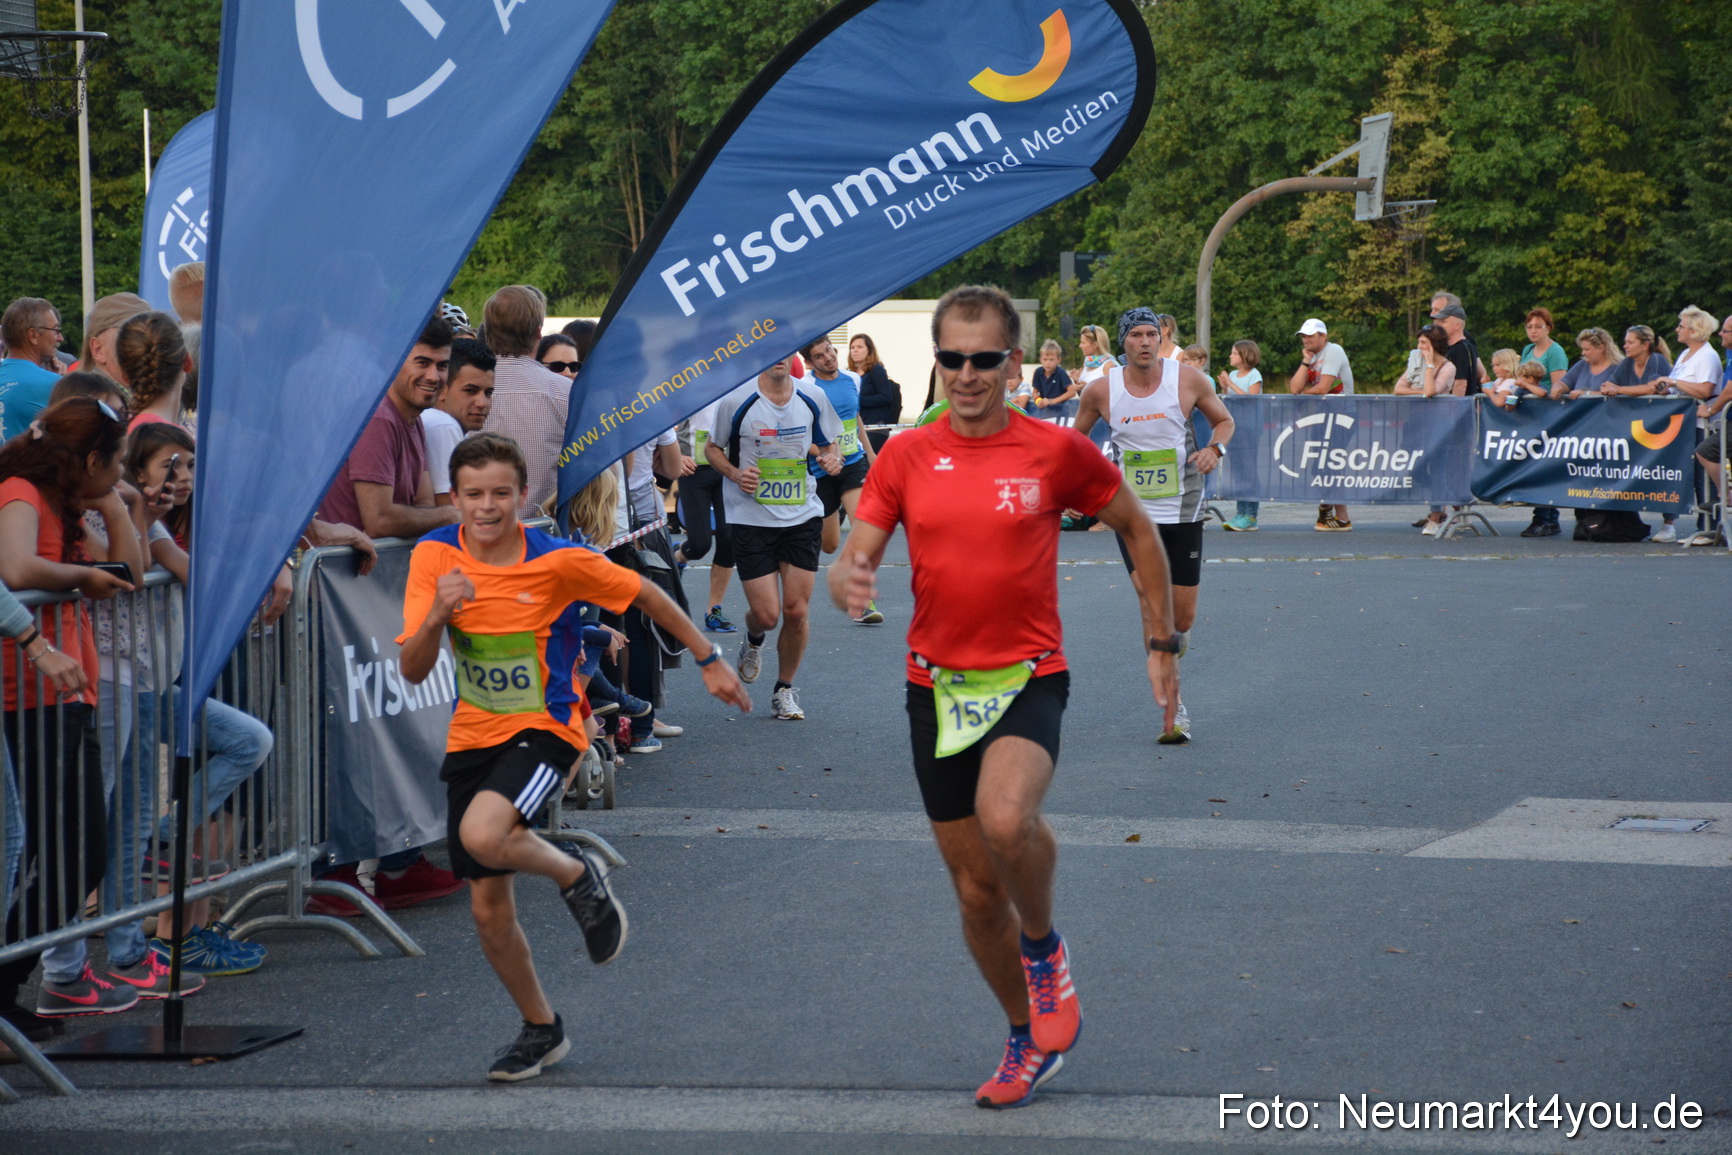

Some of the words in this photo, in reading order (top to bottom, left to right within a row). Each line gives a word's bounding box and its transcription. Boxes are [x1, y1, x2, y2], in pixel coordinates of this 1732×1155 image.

[883, 174, 966, 230] Druck
[967, 147, 1023, 183] und
[1020, 90, 1120, 159] Medien
[660, 112, 1003, 317] Frischmann
[557, 318, 777, 468] www.frischmann-net.de
[1300, 441, 1424, 471] Fischer
[1483, 430, 1630, 461] Frischmann
[1135, 468, 1168, 486] 575
[1311, 475, 1413, 488] AUTOMOBILE
[1567, 463, 1602, 478] Druck
[1605, 466, 1630, 479] und
[1631, 466, 1683, 481] Medien
[759, 481, 802, 499] 2001
[1568, 487, 1680, 503] www.frischmann-net.de
[461, 659, 532, 692] 1296
